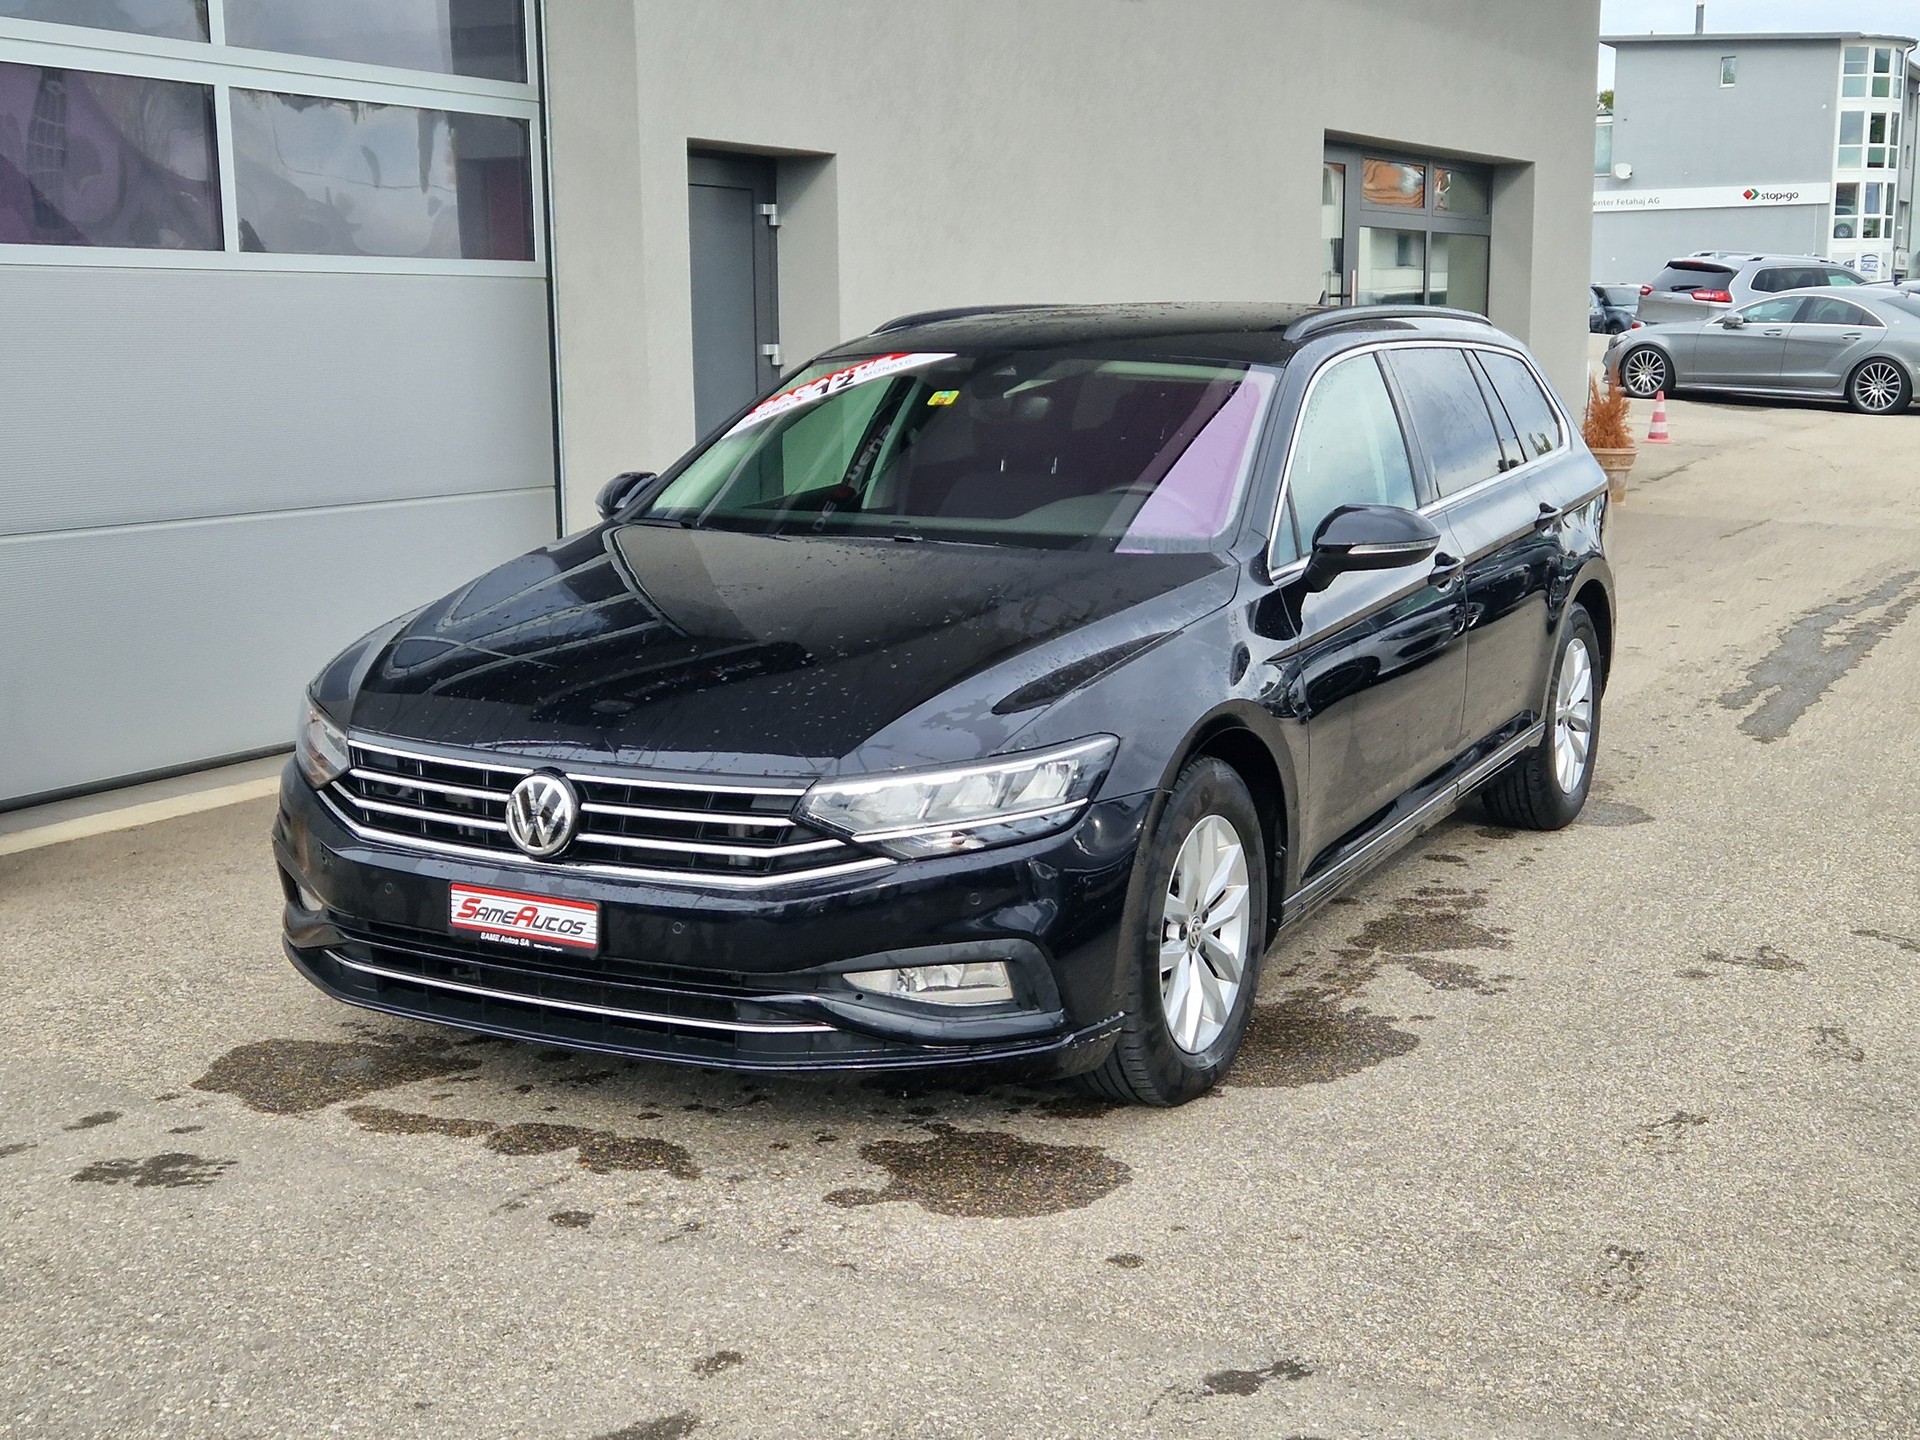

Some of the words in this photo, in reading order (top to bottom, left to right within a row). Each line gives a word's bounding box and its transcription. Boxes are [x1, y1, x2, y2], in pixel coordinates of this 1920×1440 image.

[1648, 196, 1661, 204] AG
[480, 931, 500, 942] SAME
[500, 934, 519, 945] Autos
[519, 938, 530, 947] SA
